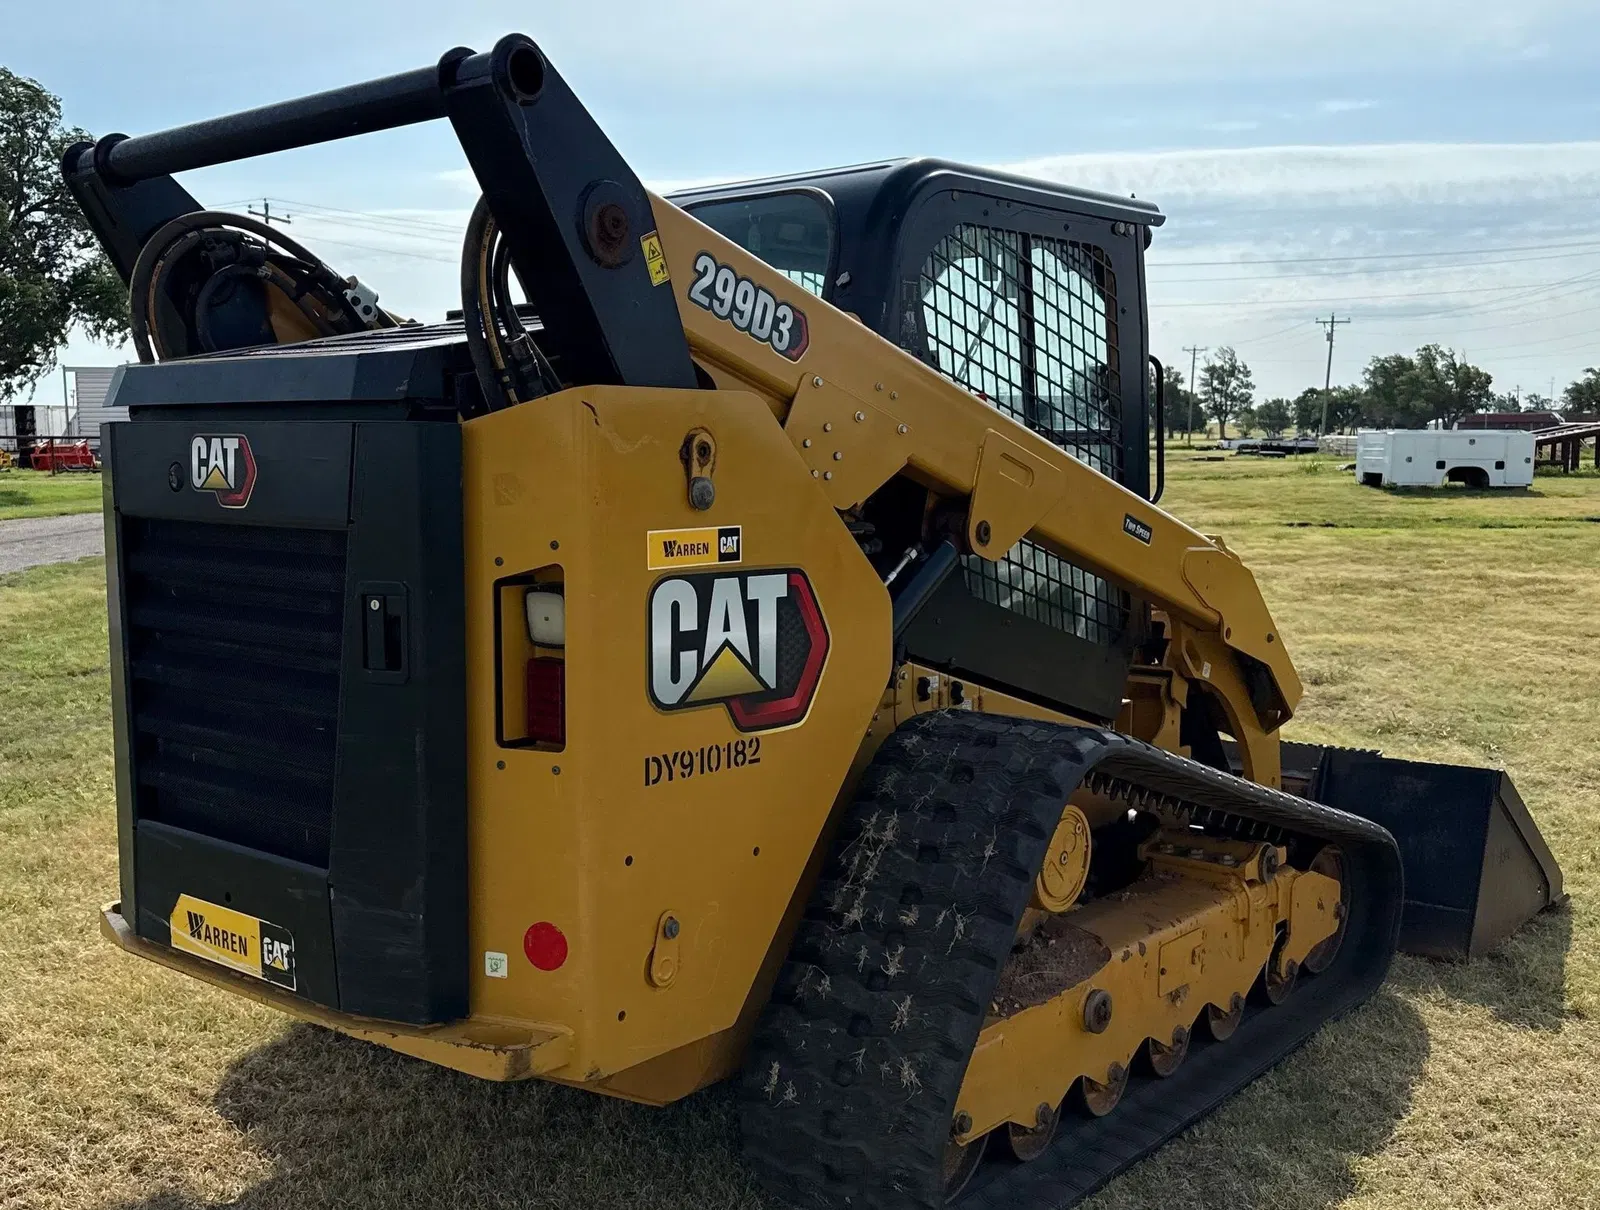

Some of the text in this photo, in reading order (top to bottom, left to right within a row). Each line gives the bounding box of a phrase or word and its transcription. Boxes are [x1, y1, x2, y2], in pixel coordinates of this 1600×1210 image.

[690, 255, 794, 351] 299D3
[191, 437, 239, 489] CAT
[663, 536, 738, 557] WARREN CAT
[652, 574, 788, 705] CAT
[645, 737, 760, 786] DY910182
[187, 910, 290, 971] WARREN CAT
